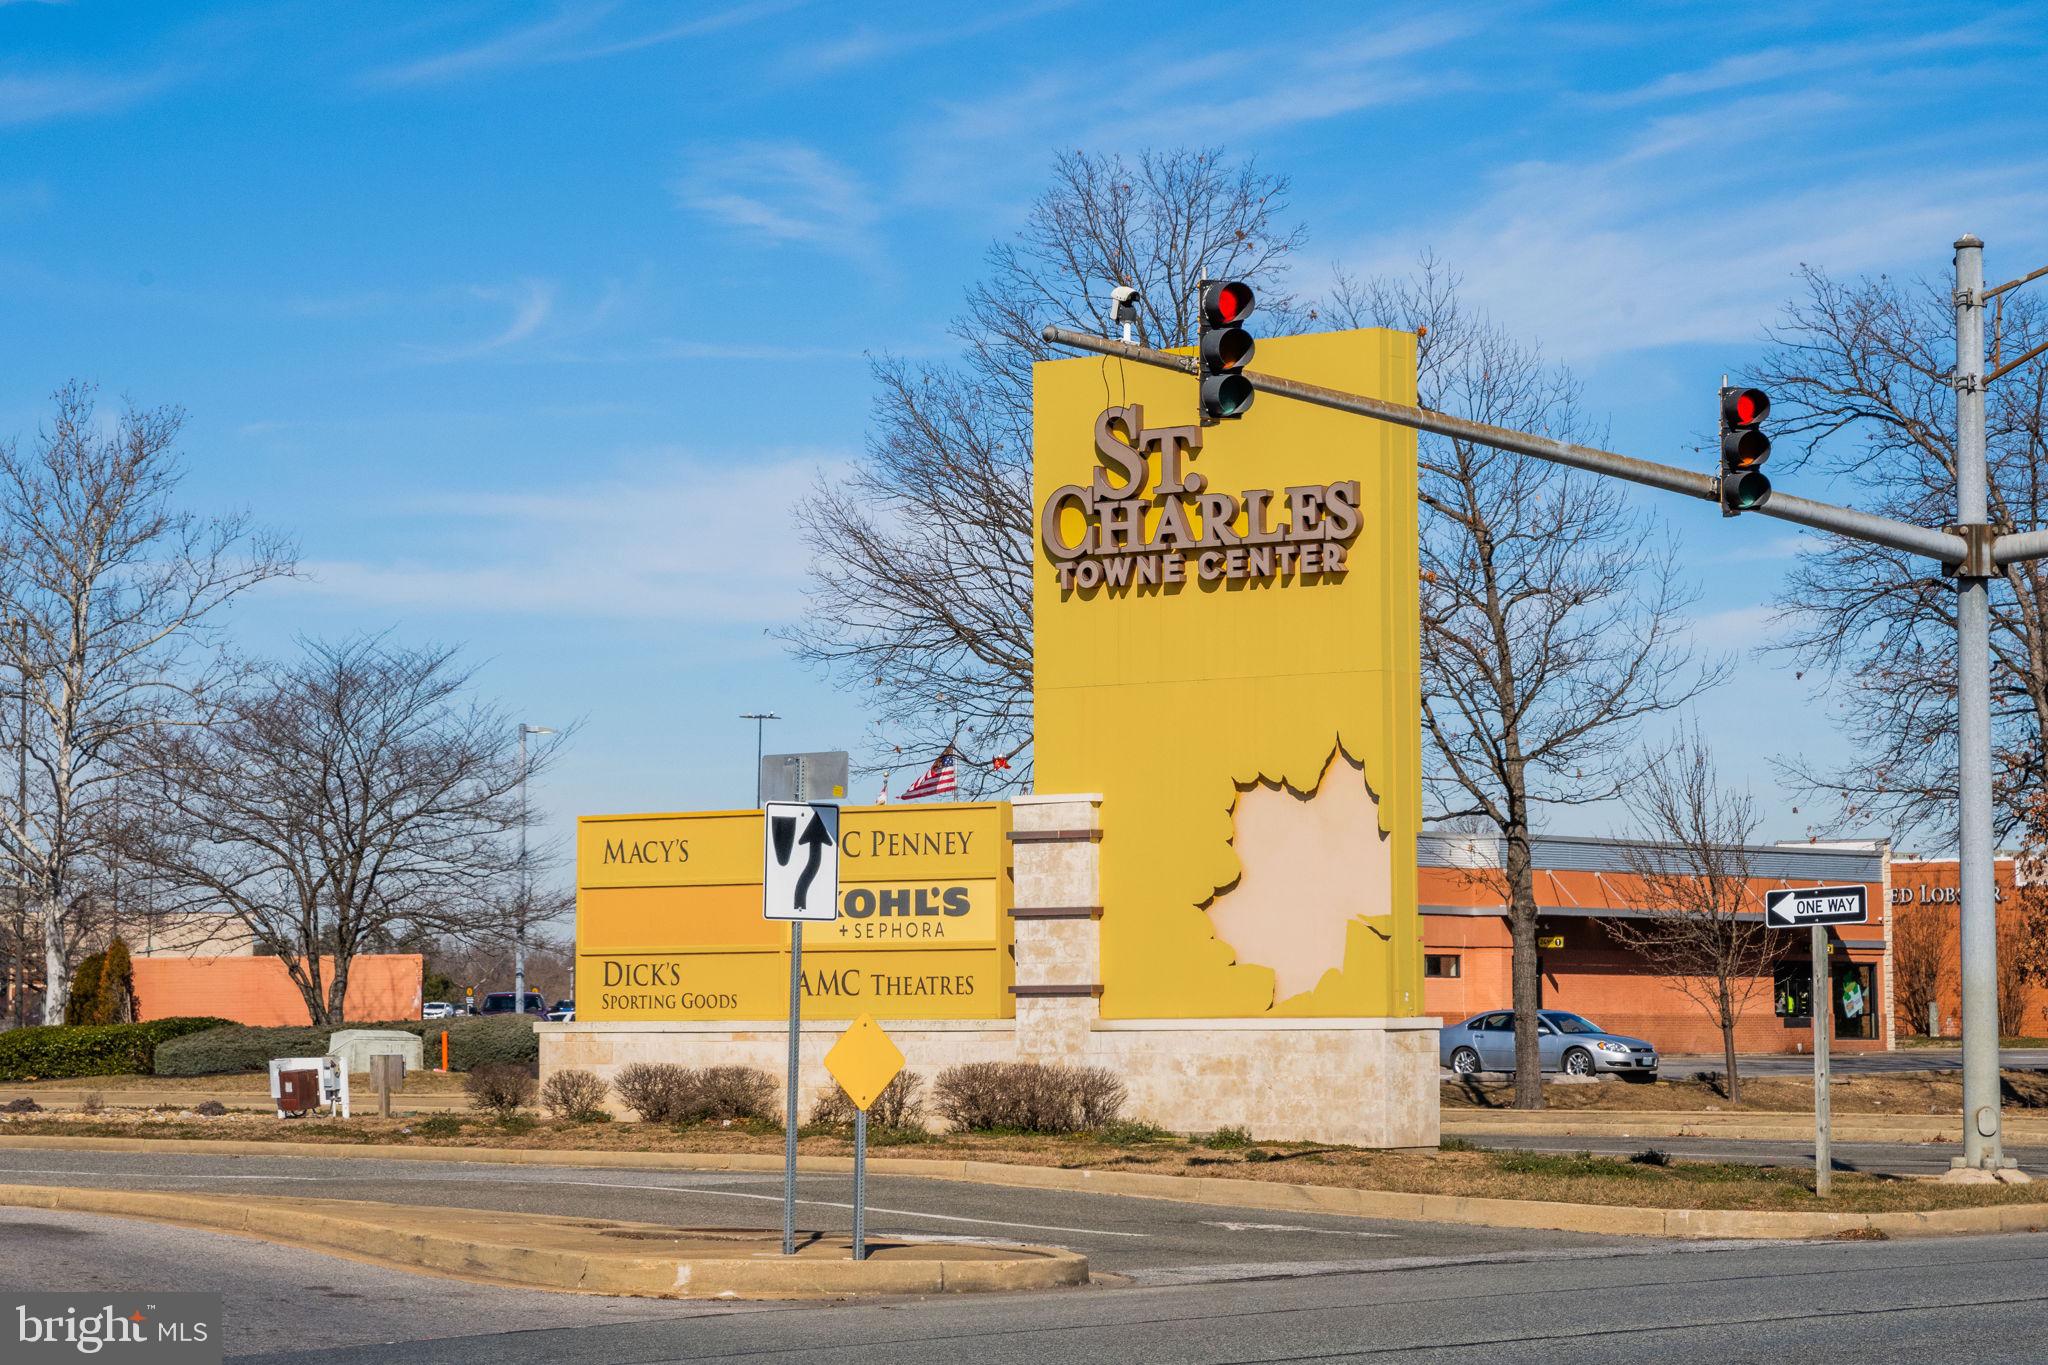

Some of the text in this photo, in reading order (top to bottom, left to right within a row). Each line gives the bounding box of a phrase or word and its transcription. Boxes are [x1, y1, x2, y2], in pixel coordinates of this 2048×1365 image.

[1093, 403, 1208, 500] ST.
[1041, 480, 1364, 560] CHARLES
[1055, 542, 1349, 591] TOWNE CENTER
[603, 838, 690, 865] MACY'S
[841, 830, 974, 858] C PENNEY
[1796, 897, 1855, 914] ONE WAY
[1890, 887, 1914, 903] ED
[854, 922, 945, 939] SEPHORA
[603, 961, 681, 987] DICK'S
[800, 969, 975, 997] AMC THEATRES
[602, 992, 738, 1010] SPORTING GOODS
